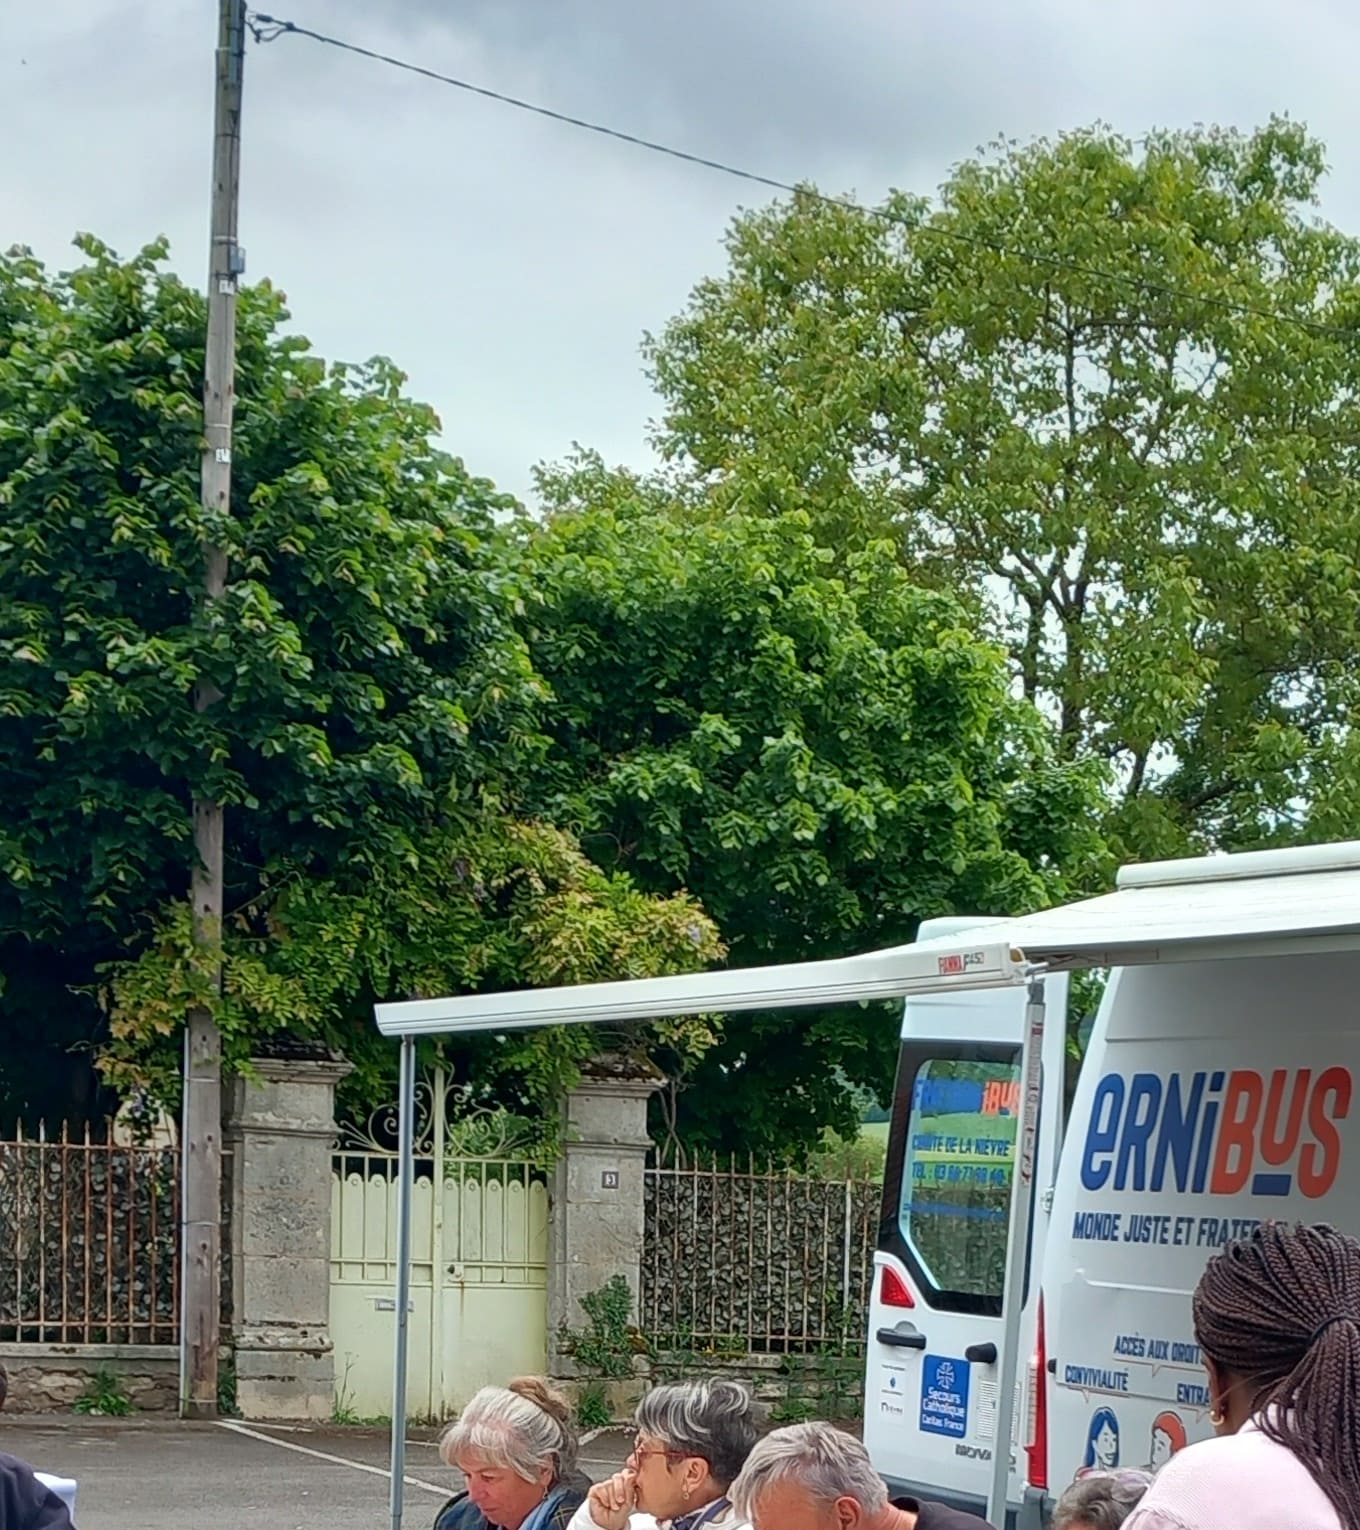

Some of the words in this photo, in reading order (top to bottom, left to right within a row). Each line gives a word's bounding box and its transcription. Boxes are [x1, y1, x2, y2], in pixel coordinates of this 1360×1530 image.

[1072, 1211, 1121, 1241] MONDE
[1123, 1213, 1171, 1245] JUSTE
[1172, 1215, 1195, 1246] ET
[1113, 1332, 1146, 1358] ACCÈS
[1147, 1339, 1170, 1359] AUX
[1171, 1342, 1202, 1365] DROIT
[1065, 1364, 1129, 1392] CONVIVIALITÉ
[922, 1398, 966, 1418] Catholique
[927, 1386, 961, 1404] Secours
[1176, 1383, 1210, 1407] ENTRA
